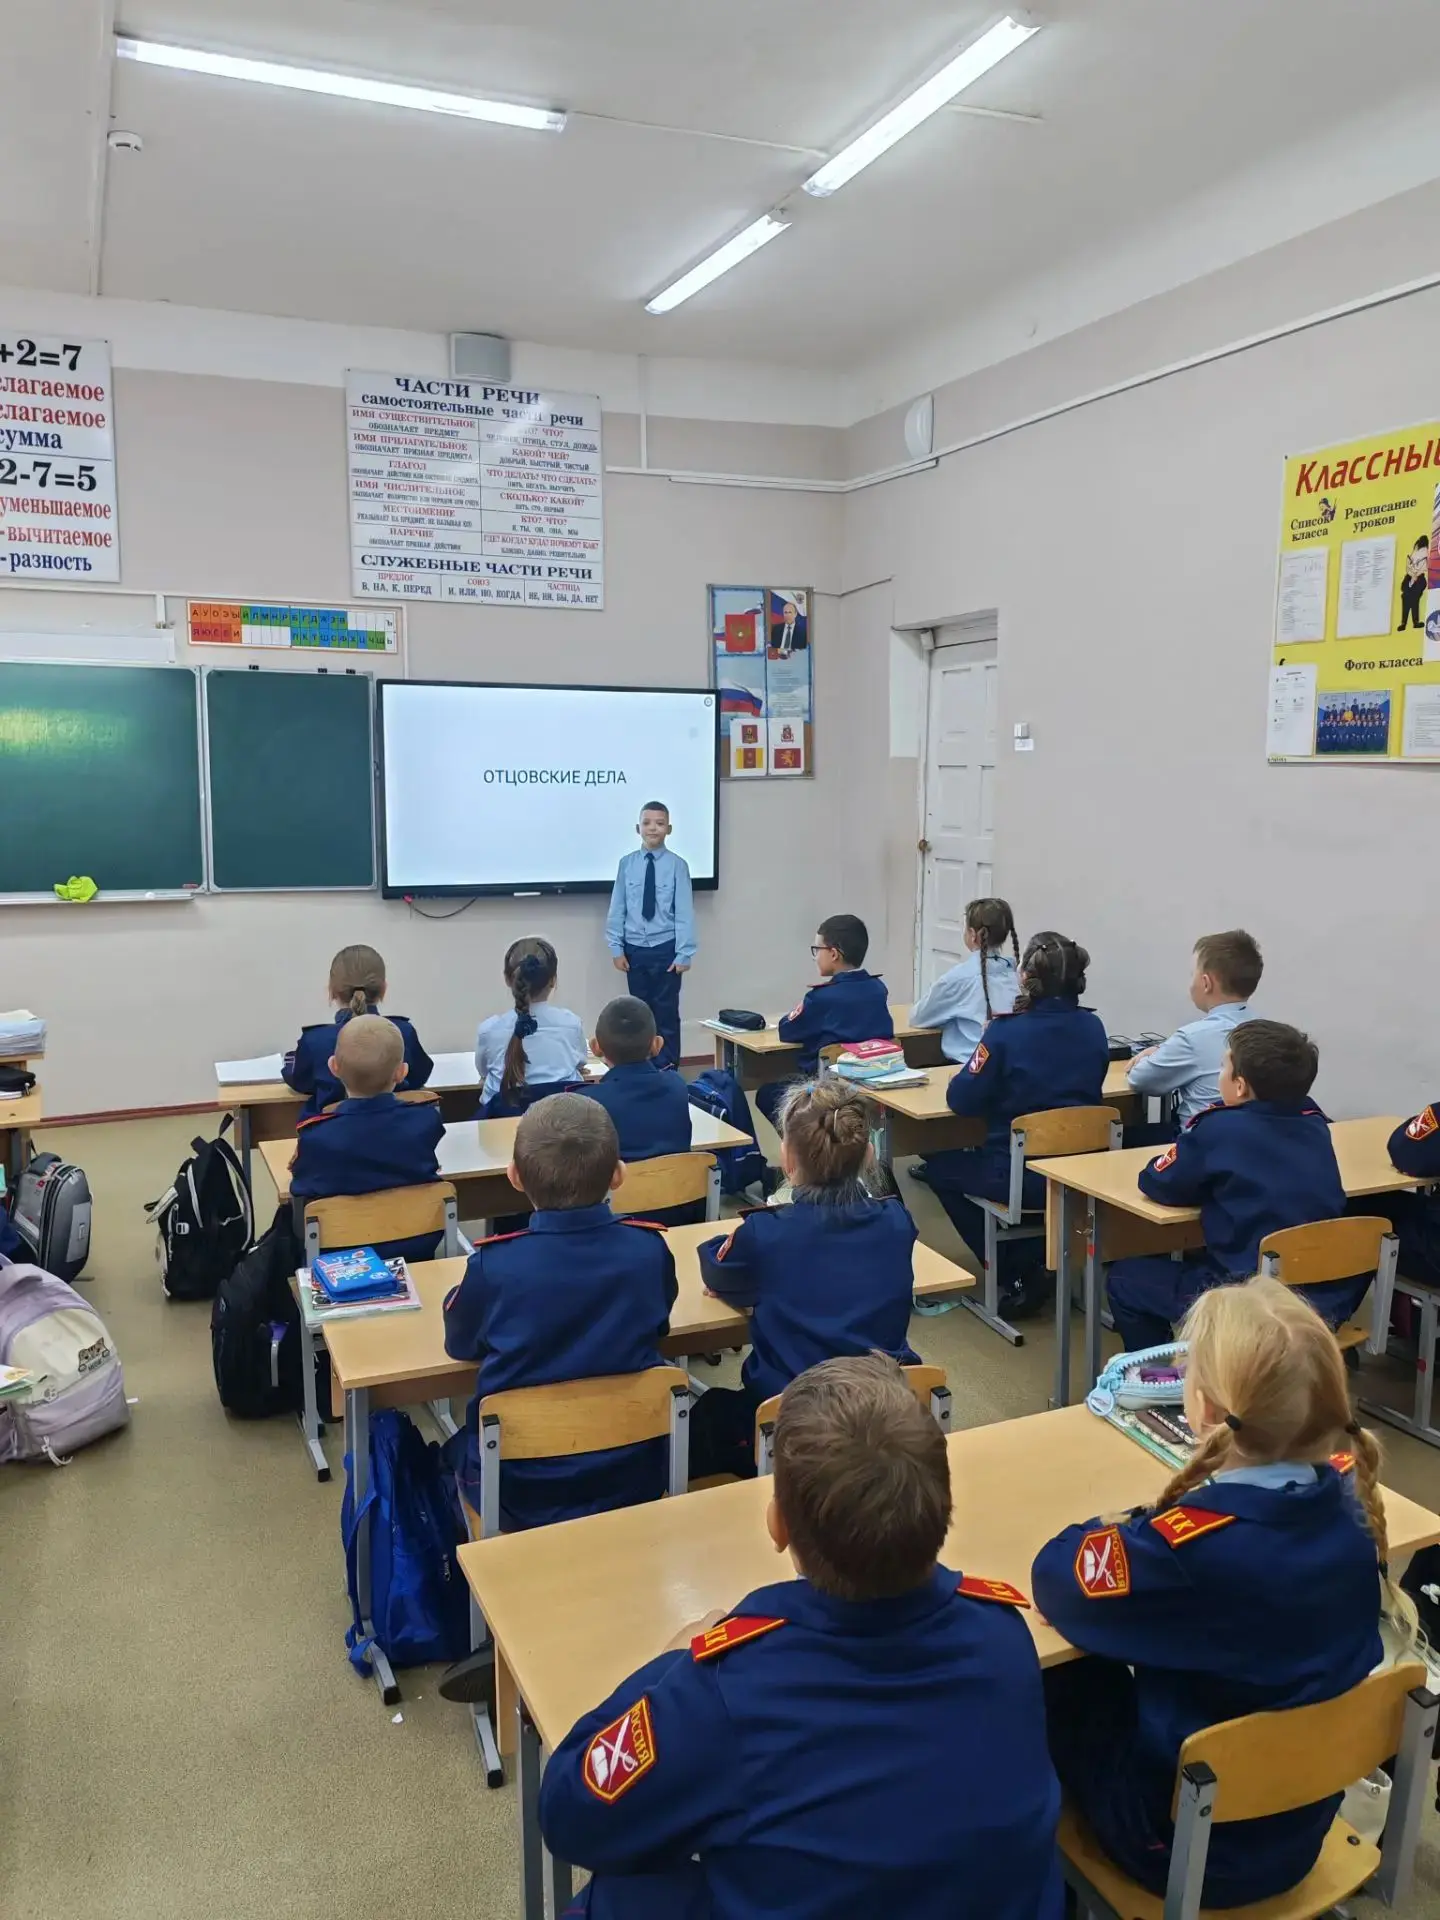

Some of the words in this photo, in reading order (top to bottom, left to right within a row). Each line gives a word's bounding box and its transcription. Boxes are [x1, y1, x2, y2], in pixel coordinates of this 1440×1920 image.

[0, 376, 104, 401] лагаемое
[394, 377, 471, 399] ЧАСТИ
[482, 387, 540, 405] РЕЧИ
[362, 394, 494, 416] самостоятельные
[550, 413, 583, 426] речи
[352, 409, 375, 418] ИМЯ
[379, 411, 476, 429] СУЩЕСТВИТЕЛЬНОЕ
[424, 427, 460, 437] ПРЕДМЕТ
[542, 428, 564, 438] ЧТО?
[353, 433, 376, 443] ИМЯ
[380, 435, 468, 451] ПРИЛАГАТЕЛЬНОЕ
[388, 460, 427, 471] ГЛАГОЛ
[486, 469, 503, 477] ЧТО
[504, 470, 539, 480] ДЕЛАТЬ?
[541, 474, 557, 482] ЧТО
[559, 475, 597, 486] СДЕЛАТЬ?
[355, 480, 378, 489] ИМЯ
[383, 482, 466, 497] ЧИСЛИТЕЛЬНОЕ
[500, 492, 548, 503] СКОЛЬКО?
[550, 496, 585, 507] КАКОЙ?
[382, 504, 455, 517] МЕСТОИМЕНИЕ
[1344, 498, 1417, 520] Расписание
[521, 515, 542, 524] КТО?
[546, 518, 567, 526] ЧТО?
[1290, 516, 1331, 530] Список
[1353, 515, 1396, 534] уроков
[389, 527, 434, 538] НАРЕЧИЕ
[1292, 528, 1329, 542] класса
[361, 554, 480, 573] СЛУЖЕБНЫЕ
[486, 562, 542, 577] ЧАСТИ
[547, 566, 592, 579] РЕЧИ
[377, 572, 415, 581] ПРЕДЛОГ
[467, 577, 490, 586] СОЮЗ
[403, 584, 432, 595] ПЕРЕД
[547, 582, 580, 592] ЧАСТИЦА
[496, 590, 521, 601] КОГДА
[585, 595, 598, 603] НЕТ
[1344, 659, 1375, 671] Фото
[1379, 657, 1423, 669] класса
[483, 769, 581, 786] ОТЦОВСКИЕ
[584, 770, 627, 787] ДЕЛА
[1111, 1532, 1126, 1588] РОССИЯ
[631, 1703, 650, 1764] РОССИЯ
